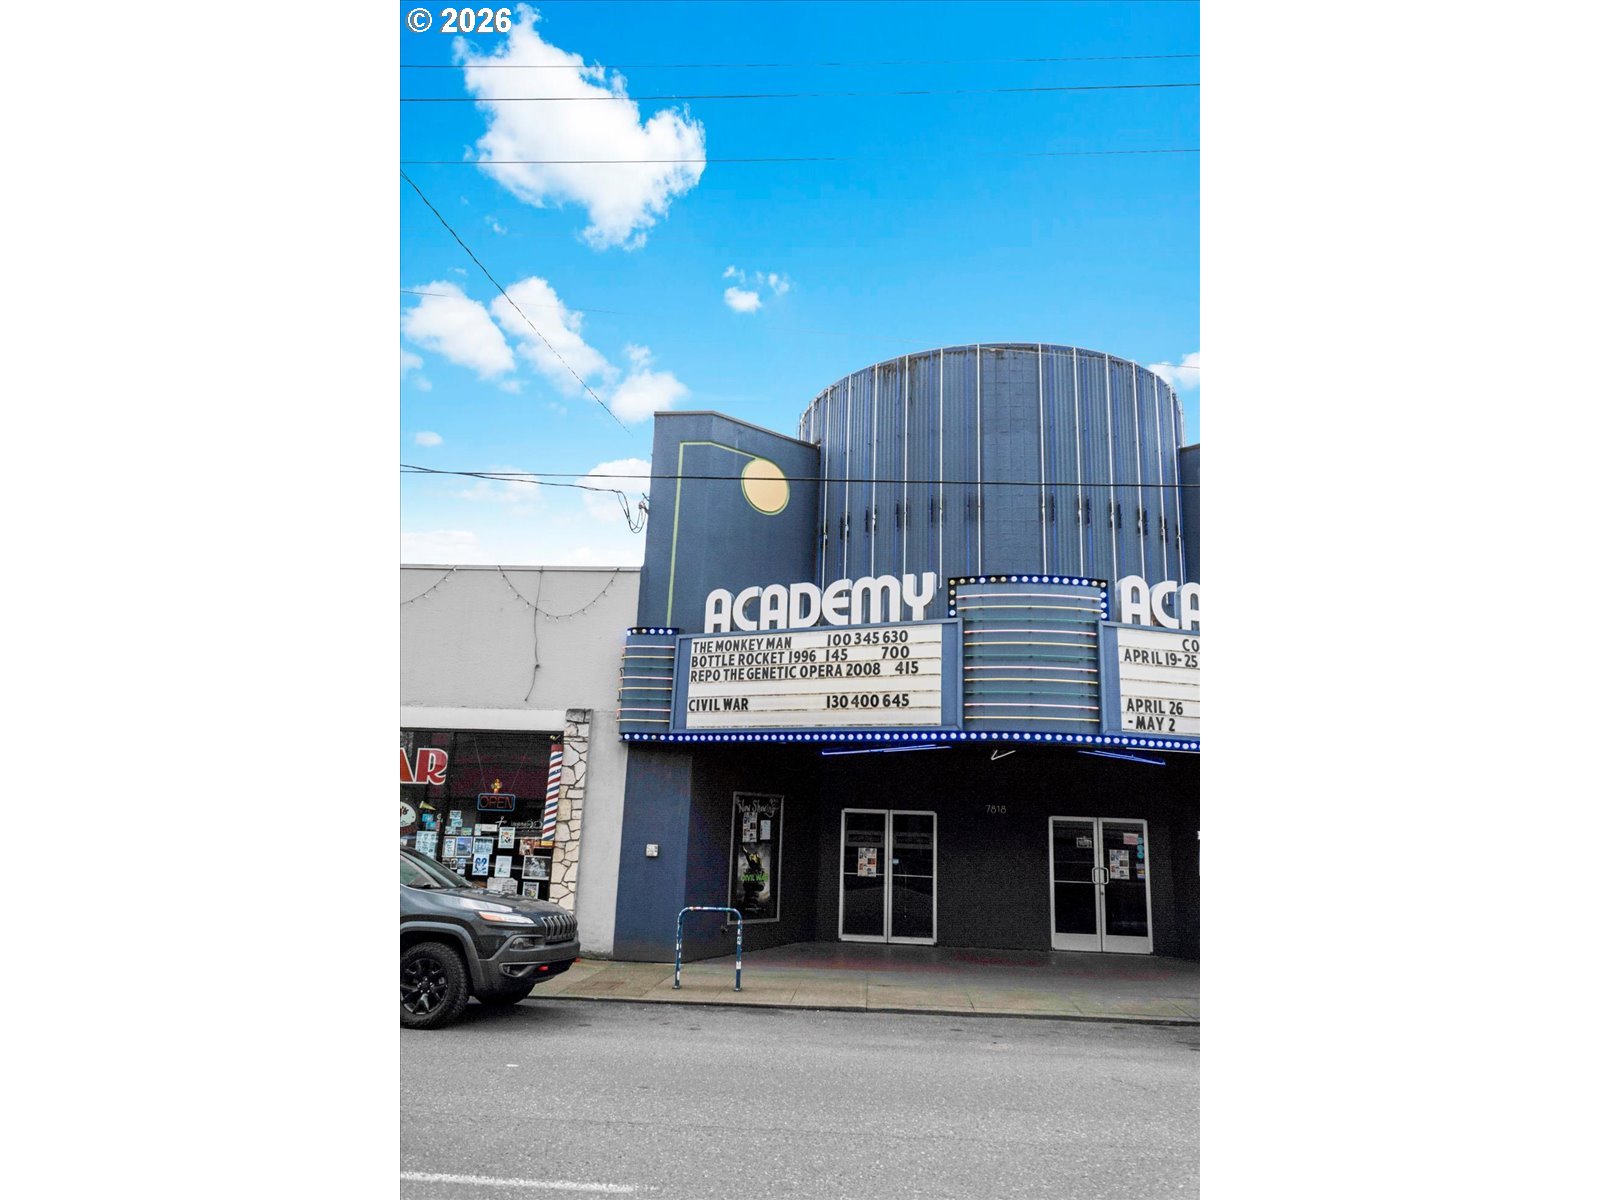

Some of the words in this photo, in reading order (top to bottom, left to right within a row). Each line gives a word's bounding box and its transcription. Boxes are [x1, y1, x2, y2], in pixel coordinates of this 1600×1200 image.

[704, 571, 937, 634] ACADEMY
[693, 641, 714, 653] THE
[715, 638, 764, 652] MONKEY
[766, 636, 792, 649] MAN
[827, 633, 852, 646] 100
[854, 632, 879, 645] 345
[882, 630, 908, 643] 630
[1182, 638, 1200, 653] CO
[691, 654, 735, 667] BOTTLE
[738, 651, 785, 665] ROCKET
[789, 649, 817, 663] 1996
[826, 648, 848, 661] 145
[881, 645, 910, 659] 700
[1124, 648, 1163, 665] APRIL
[1166, 652, 1198, 668] 19-25
[690, 669, 720, 682] REPO
[723, 668, 745, 680] THE
[746, 666, 797, 680] GENETIC
[799, 664, 843, 678] OPERA
[846, 662, 881, 676] 2008
[895, 661, 919, 674] 415
[688, 699, 721, 711] CIVIL
[723, 698, 749, 711] WAR
[826, 695, 849, 709] 130
[851, 694, 880, 708] 400
[882, 693, 910, 707] 645
[1126, 698, 1166, 714] APRIL
[1169, 701, 1184, 715] 26
[1168, 718, 1176, 732] 2
[479, 796, 512, 808] OPEN
[985, 804, 1007, 814] 7818
